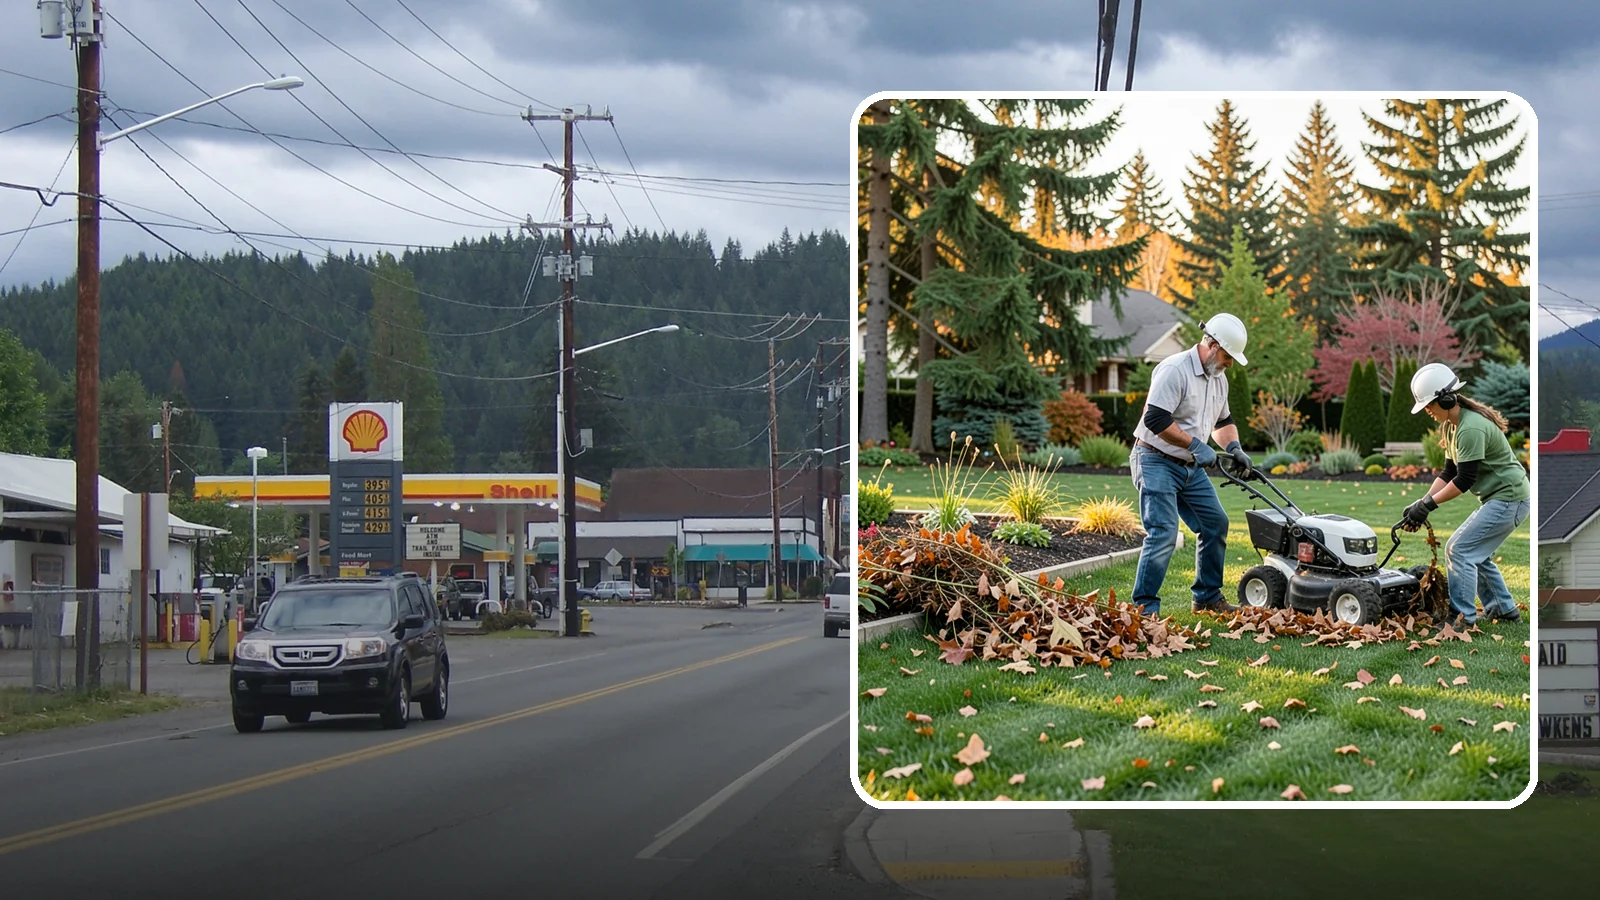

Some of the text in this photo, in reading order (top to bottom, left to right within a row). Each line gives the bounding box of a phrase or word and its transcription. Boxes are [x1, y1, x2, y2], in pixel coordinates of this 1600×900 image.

[365, 480, 384, 490] 395
[490, 484, 547, 498] Shell
[365, 494, 384, 504] 405
[365, 508, 384, 518] 415
[365, 522, 384, 533] 429
